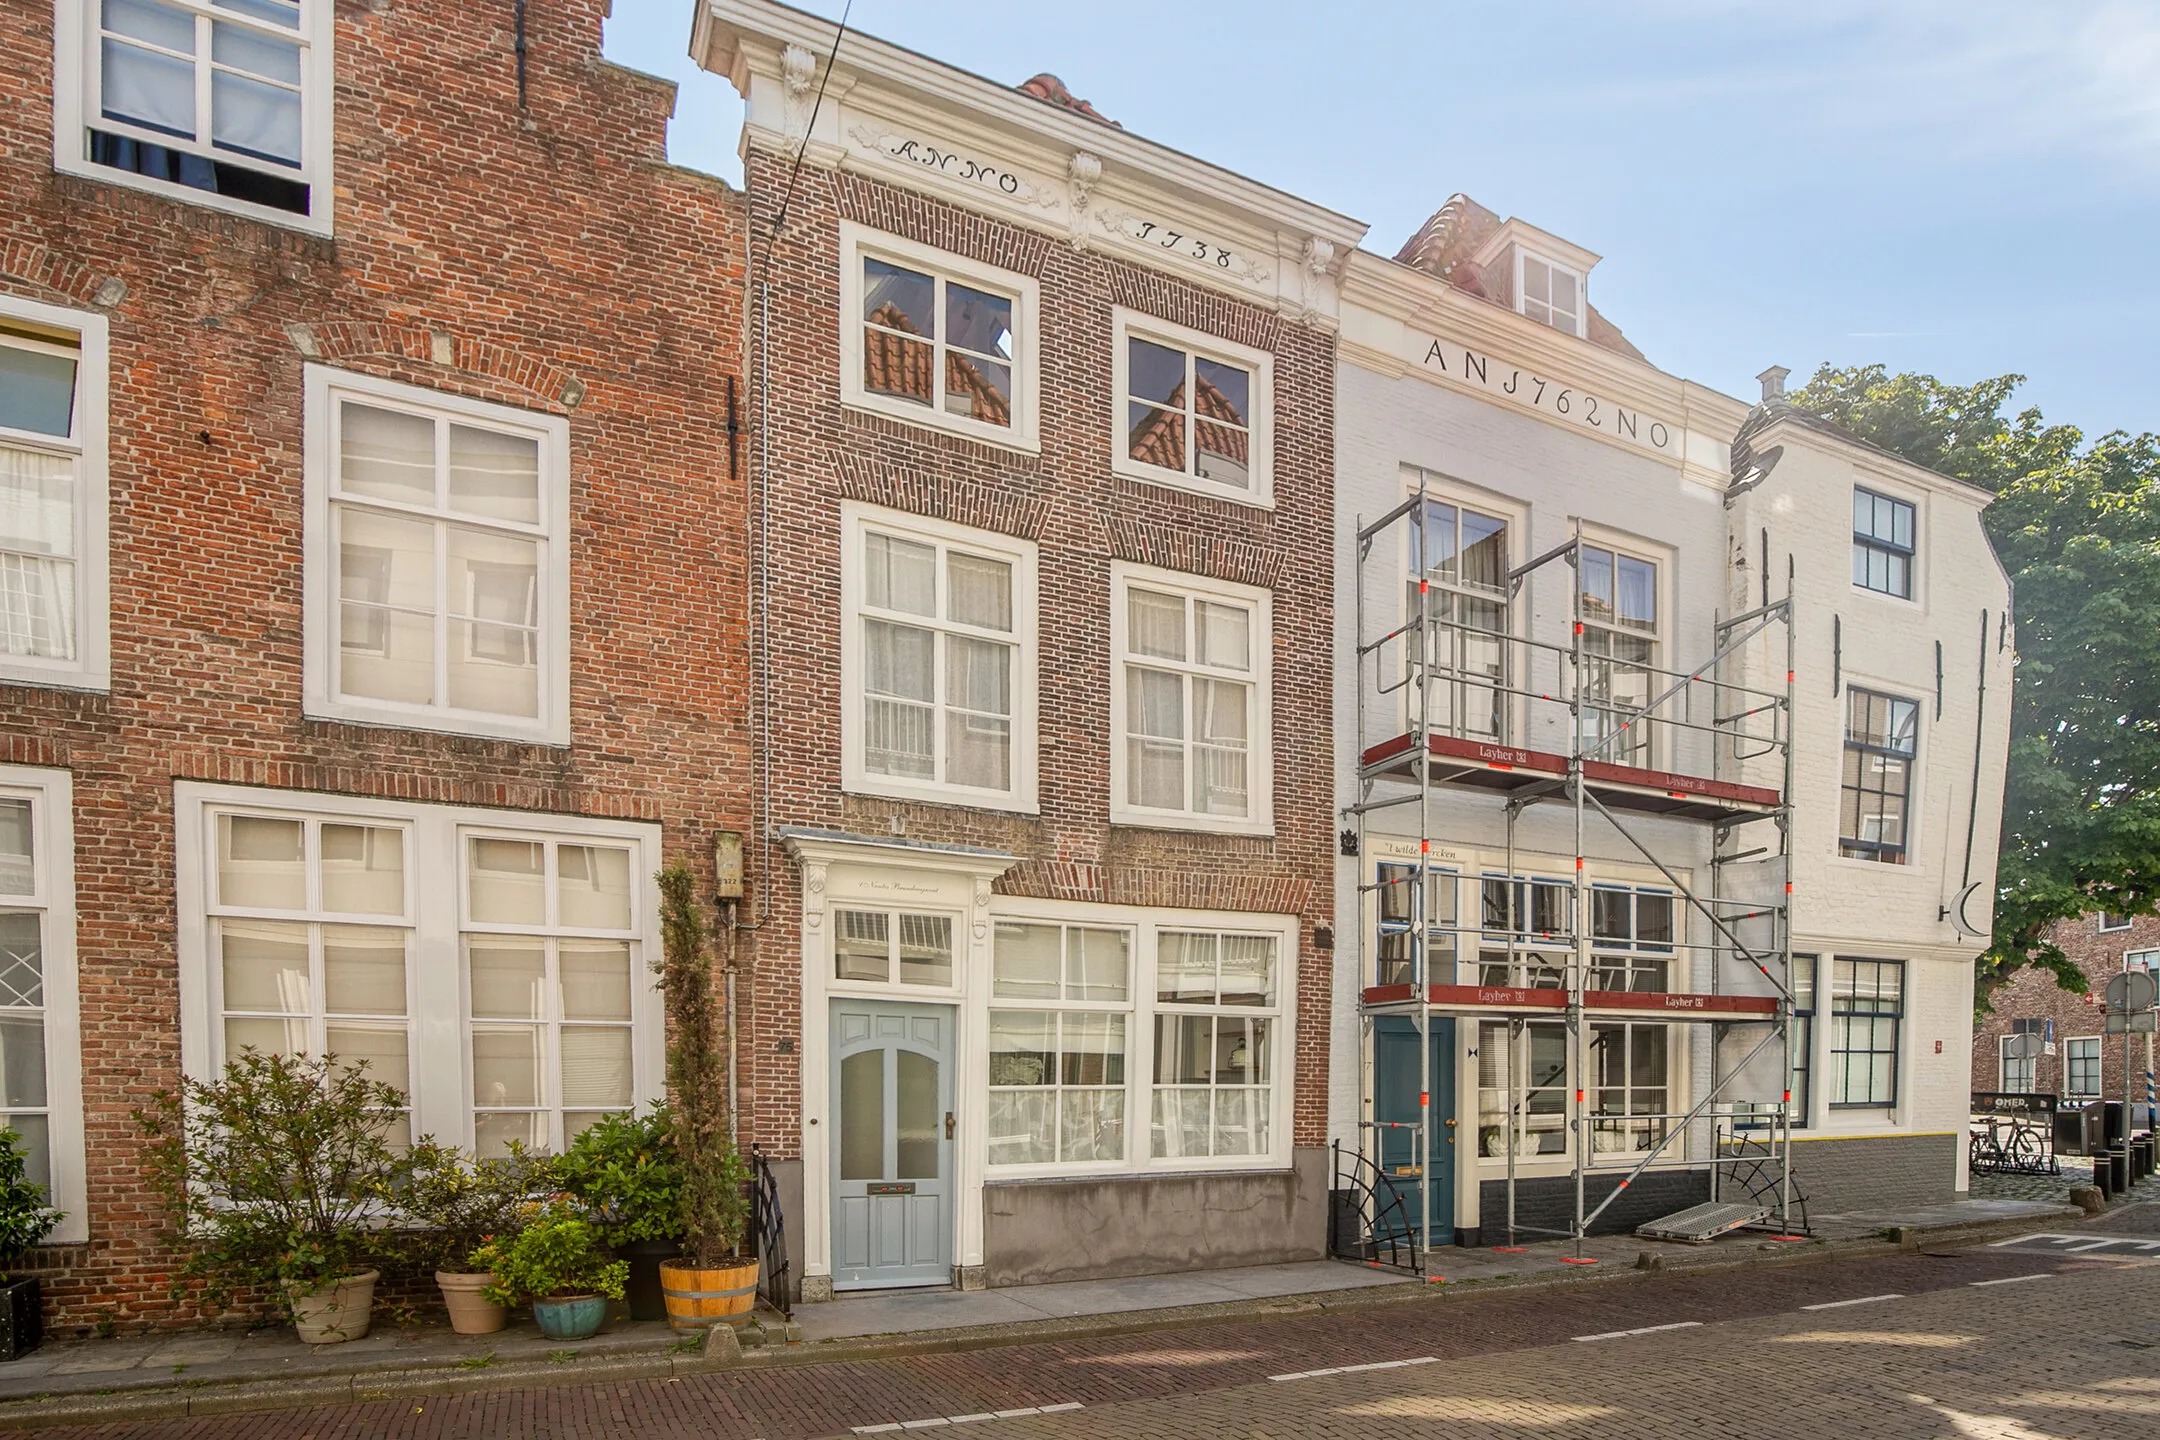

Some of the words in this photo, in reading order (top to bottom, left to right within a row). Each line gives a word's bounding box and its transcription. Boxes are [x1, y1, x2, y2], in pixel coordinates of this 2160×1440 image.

[890, 140, 1018, 194] ANNO
[1479, 745, 1514, 761] Layher
[1478, 989, 1512, 1003] Layher
[1665, 996, 1693, 1009] Layher
